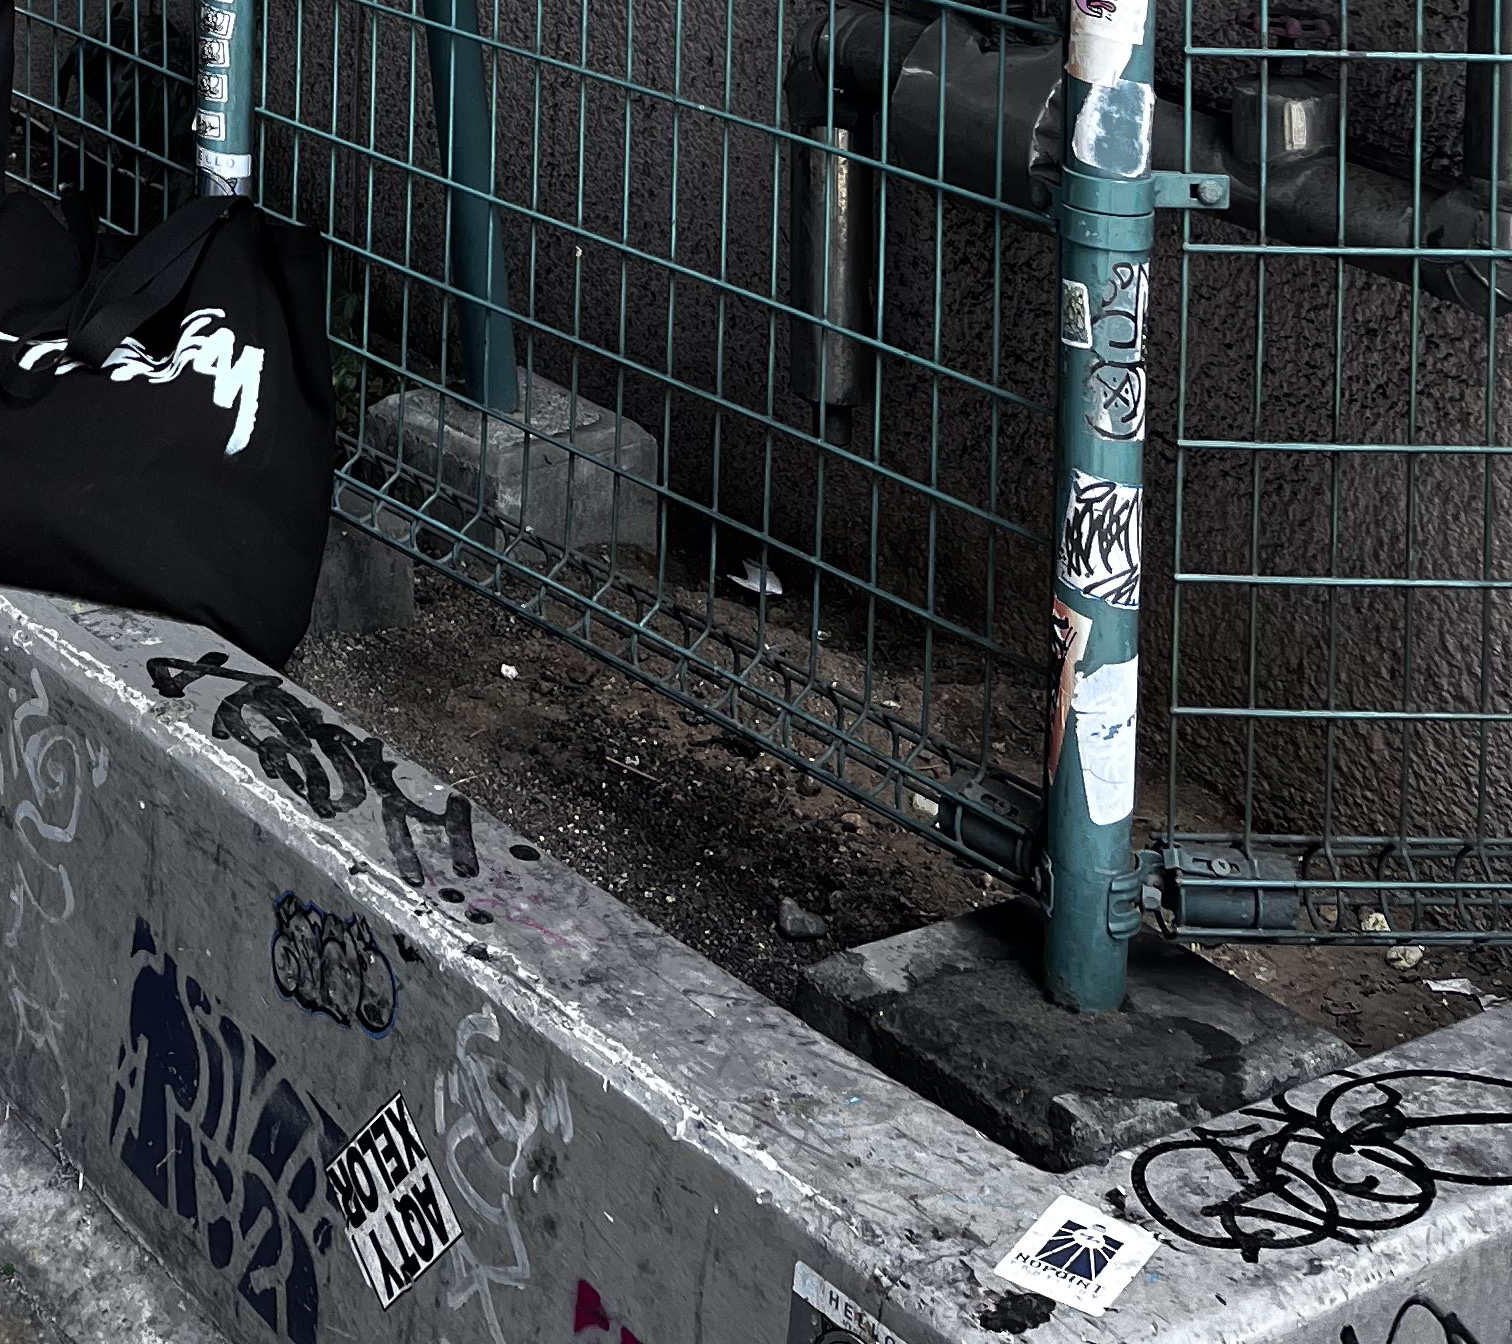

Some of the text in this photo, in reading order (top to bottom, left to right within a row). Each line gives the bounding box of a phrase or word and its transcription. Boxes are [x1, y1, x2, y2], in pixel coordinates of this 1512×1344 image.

[327, 1099, 427, 1231] XELOR
[366, 1173, 449, 1301] AQTY
[1015, 1252, 1104, 1295] NOPOINT
